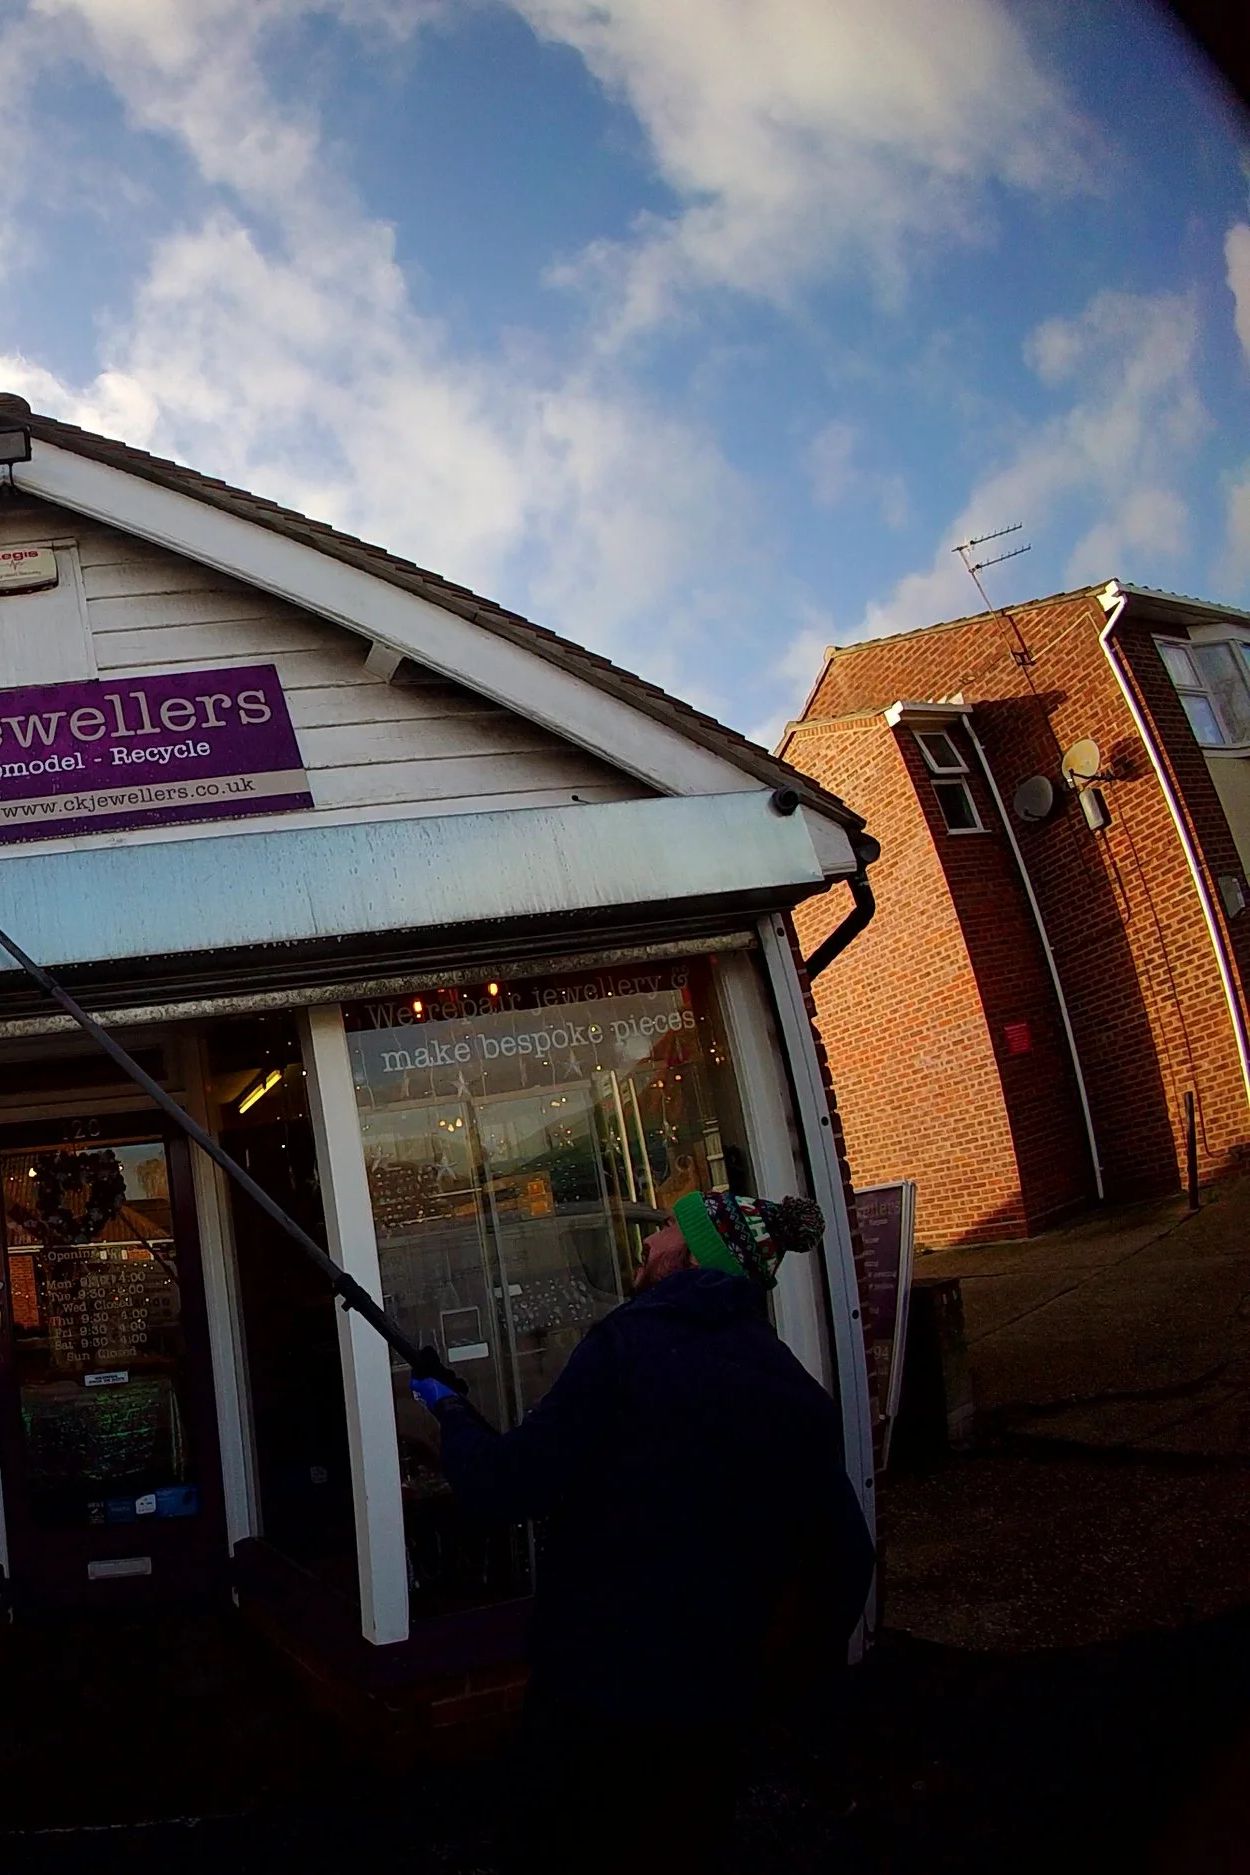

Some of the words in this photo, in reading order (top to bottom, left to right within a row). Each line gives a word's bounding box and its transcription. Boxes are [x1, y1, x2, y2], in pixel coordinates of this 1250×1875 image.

[110, 740, 211, 765] Recycle
[0, 777, 256, 819] www.ckjewellers.co.uk
[364, 1003, 415, 1029] We
[429, 990, 522, 1024] repair
[528, 974, 662, 1015] jewellery
[670, 967, 691, 988] &
[381, 1040, 472, 1074] make
[478, 1024, 604, 1060] bespoke
[611, 1007, 697, 1045] pieces
[61, 1118, 101, 1140] 120
[63, 1300, 87, 1313] Wed
